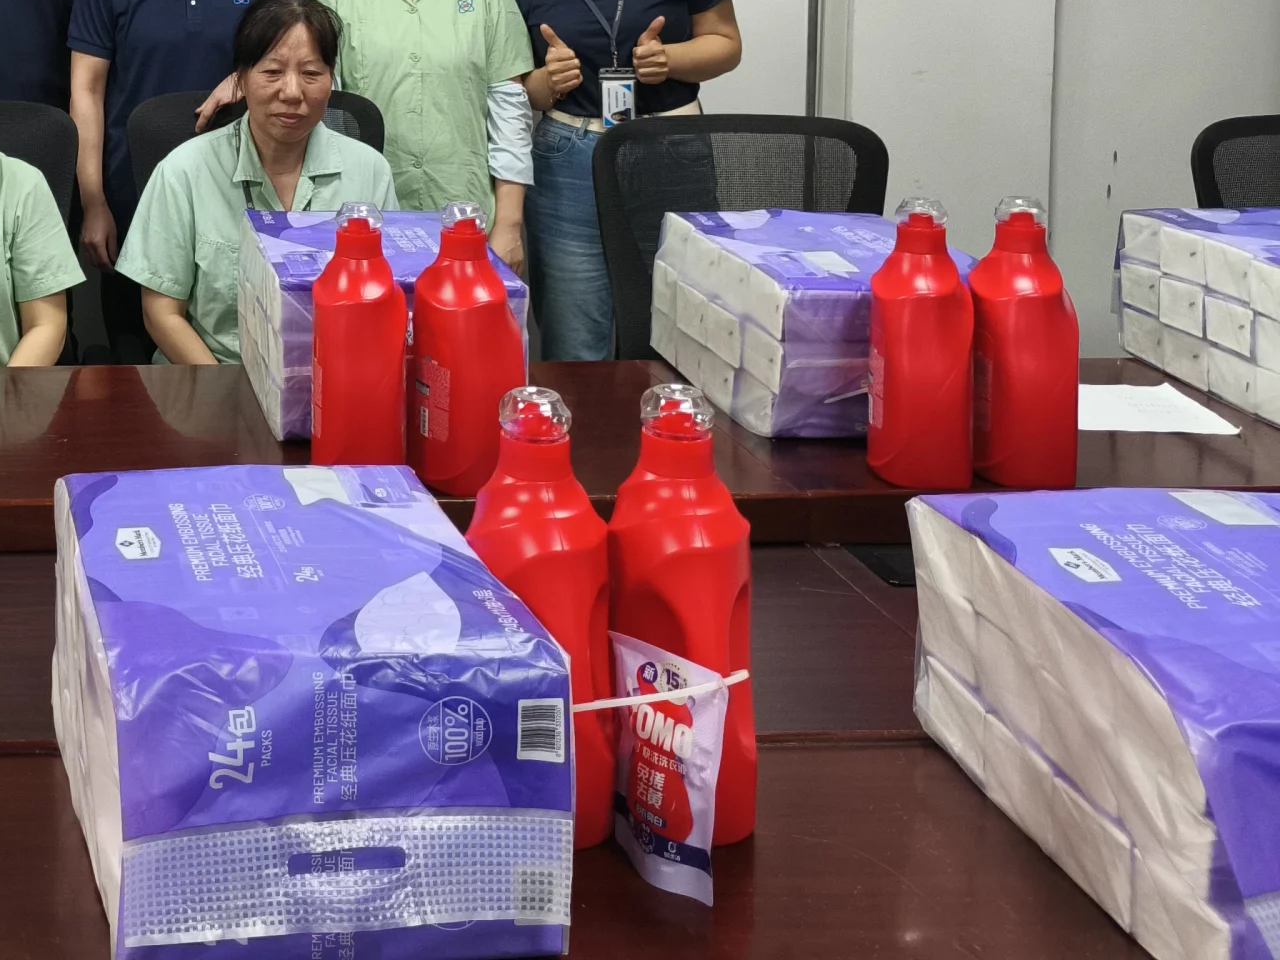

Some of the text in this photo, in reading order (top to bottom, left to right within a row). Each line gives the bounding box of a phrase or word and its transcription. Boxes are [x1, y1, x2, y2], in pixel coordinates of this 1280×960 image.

[168, 503, 214, 582] PREMIUM EMBOSSING
[192, 513, 230, 567] FACIAL TISSUE
[208, 503, 264, 578] 经典压花纸面巾
[1079, 523, 1149, 571] EMBOSSING
[1116, 534, 1212, 593] FACIAL TISSUE
[1145, 568, 1208, 609] PREMIUM
[643, 665, 656, 681] 新
[664, 668, 680, 690] 15
[208, 705, 256, 789] 24包
[260, 729, 273, 767] PACKS
[312, 671, 325, 804] PREMIUM EMBOSSING
[327, 691, 338, 783] FACIAL TISSUE
[339, 673, 358, 801] 经典压花纸面巾
[427, 715, 439, 751] 原生木浆
[444, 704, 469, 761] 100%
[474, 717, 487, 731] pulp
[636, 704, 693, 759] OMO
[636, 762, 666, 791] 免搓
[636, 781, 663, 809] 去黄
